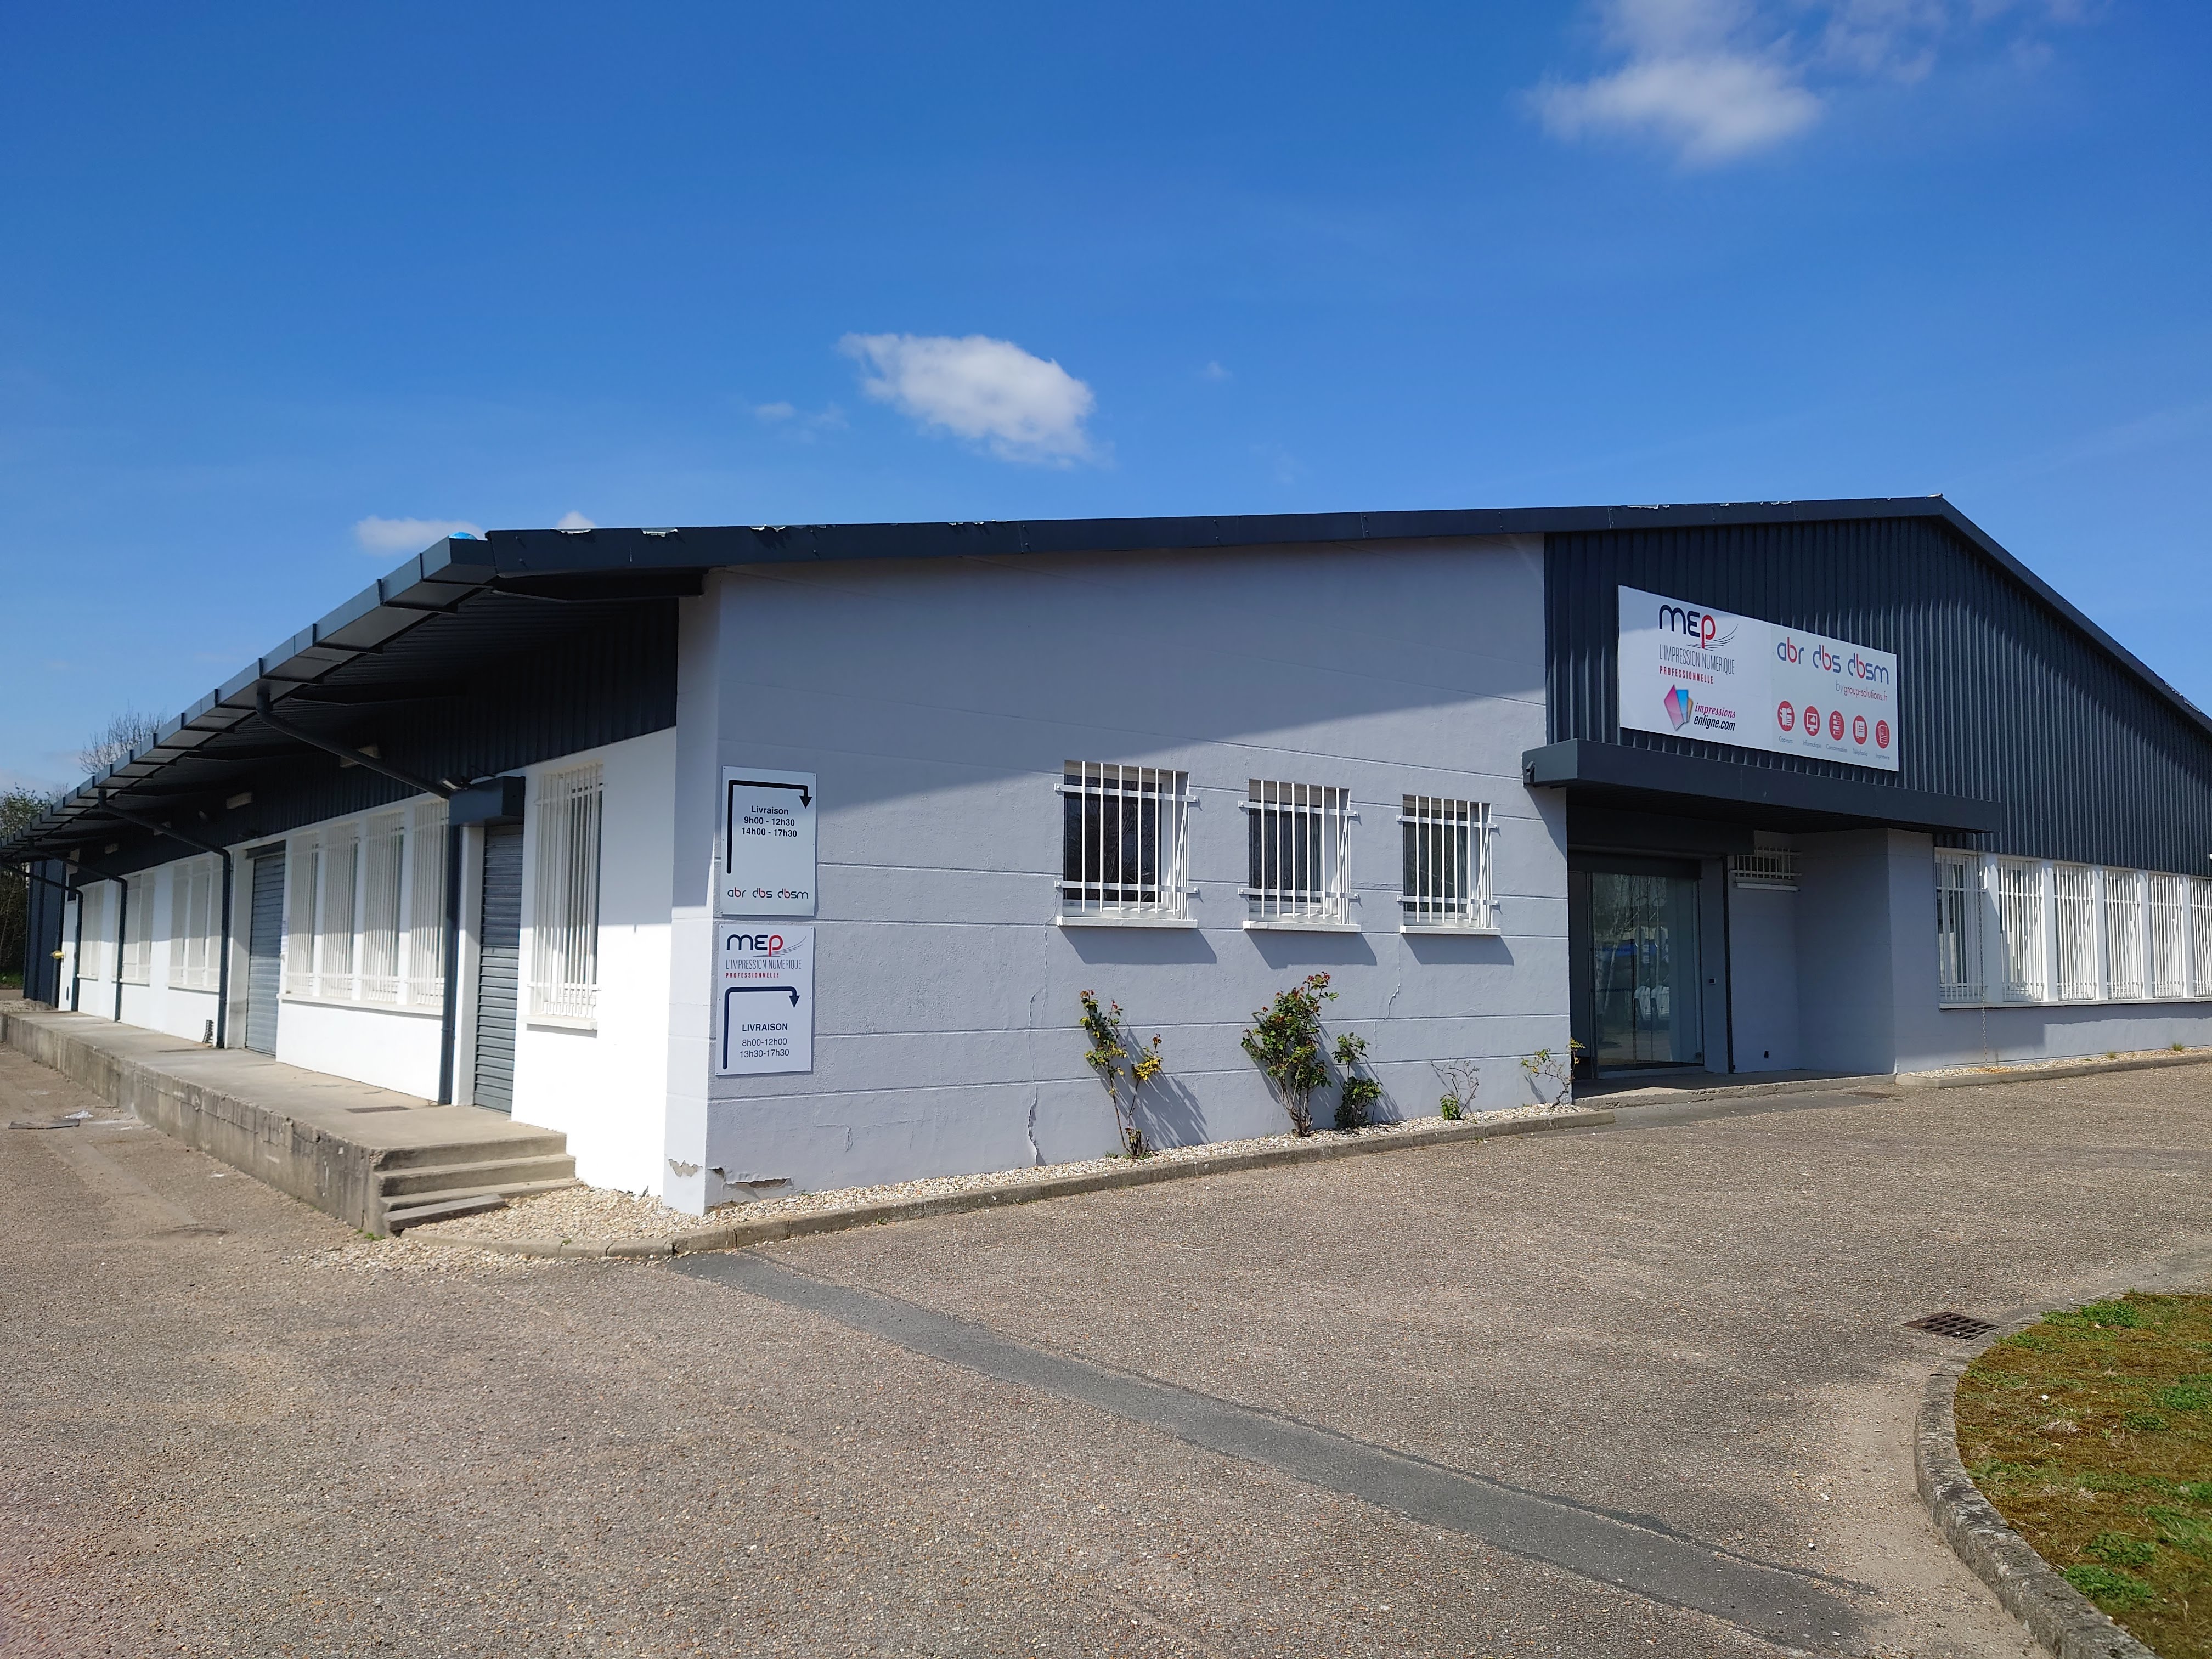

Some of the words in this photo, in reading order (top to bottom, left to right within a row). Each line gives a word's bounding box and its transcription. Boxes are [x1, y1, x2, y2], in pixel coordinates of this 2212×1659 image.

[1777, 637, 1804, 664] abr
[1660, 644, 1700, 668] L'IMPRESSION
[1702, 653, 1735, 675] NUMERIQUE
[1660, 665, 1713, 684] PROFESSIONNELLE
[1695, 702, 1735, 719] impressions
[1694, 715, 1735, 731] enligne.com
[751, 805, 788, 815] Livraison
[744, 816, 764, 825] 9h00
[771, 818, 795, 826] 12h30
[742, 827, 766, 836] 14h00
[774, 829, 797, 837] 17h30
[727, 887, 746, 898] abr
[726, 959, 766, 969] L'IMPRESSION
[769, 959, 802, 970] NUMERIQUE
[742, 1023, 788, 1031] LIVRAISON
[742, 1037, 787, 1047] 8h00-12h00
[740, 1049, 789, 1058] 13h30-17h30
